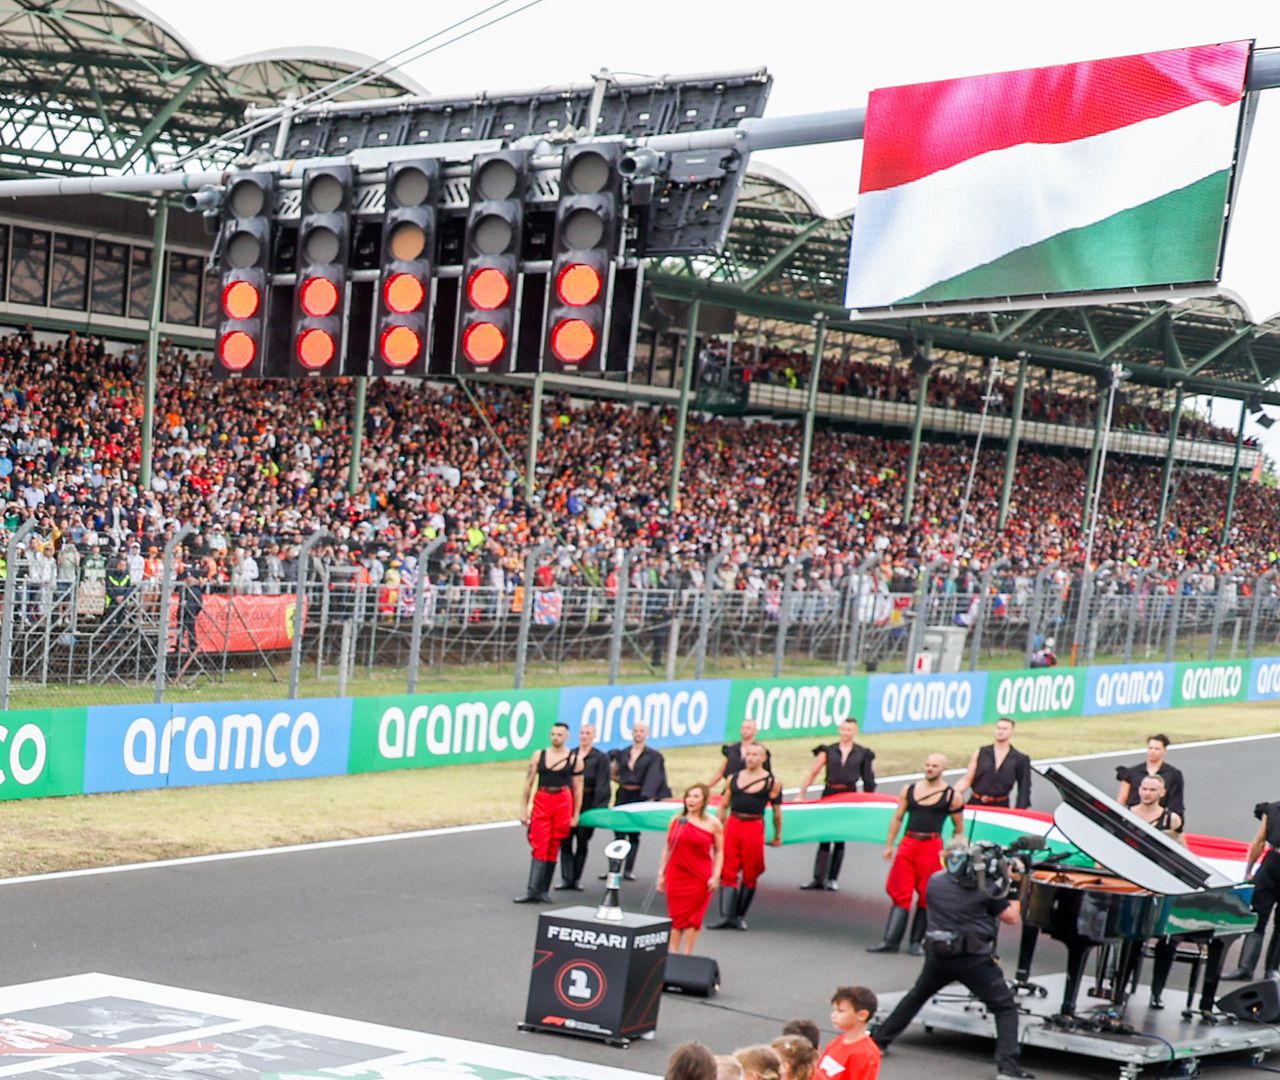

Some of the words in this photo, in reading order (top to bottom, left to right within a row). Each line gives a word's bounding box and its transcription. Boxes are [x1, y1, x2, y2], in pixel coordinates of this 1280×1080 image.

[881, 680, 971, 723] aramco
[996, 674, 1075, 714] aramco
[1096, 669, 1164, 707] aramco
[1182, 665, 1241, 700] aramco
[581, 689, 708, 745] aramco
[745, 678, 852, 730] aramco
[123, 711, 320, 775] aramco
[378, 700, 535, 759] aramco
[547, 926, 628, 949] FERRARI
[633, 931, 669, 949] FERRARI
[568, 969, 592, 999] 1
